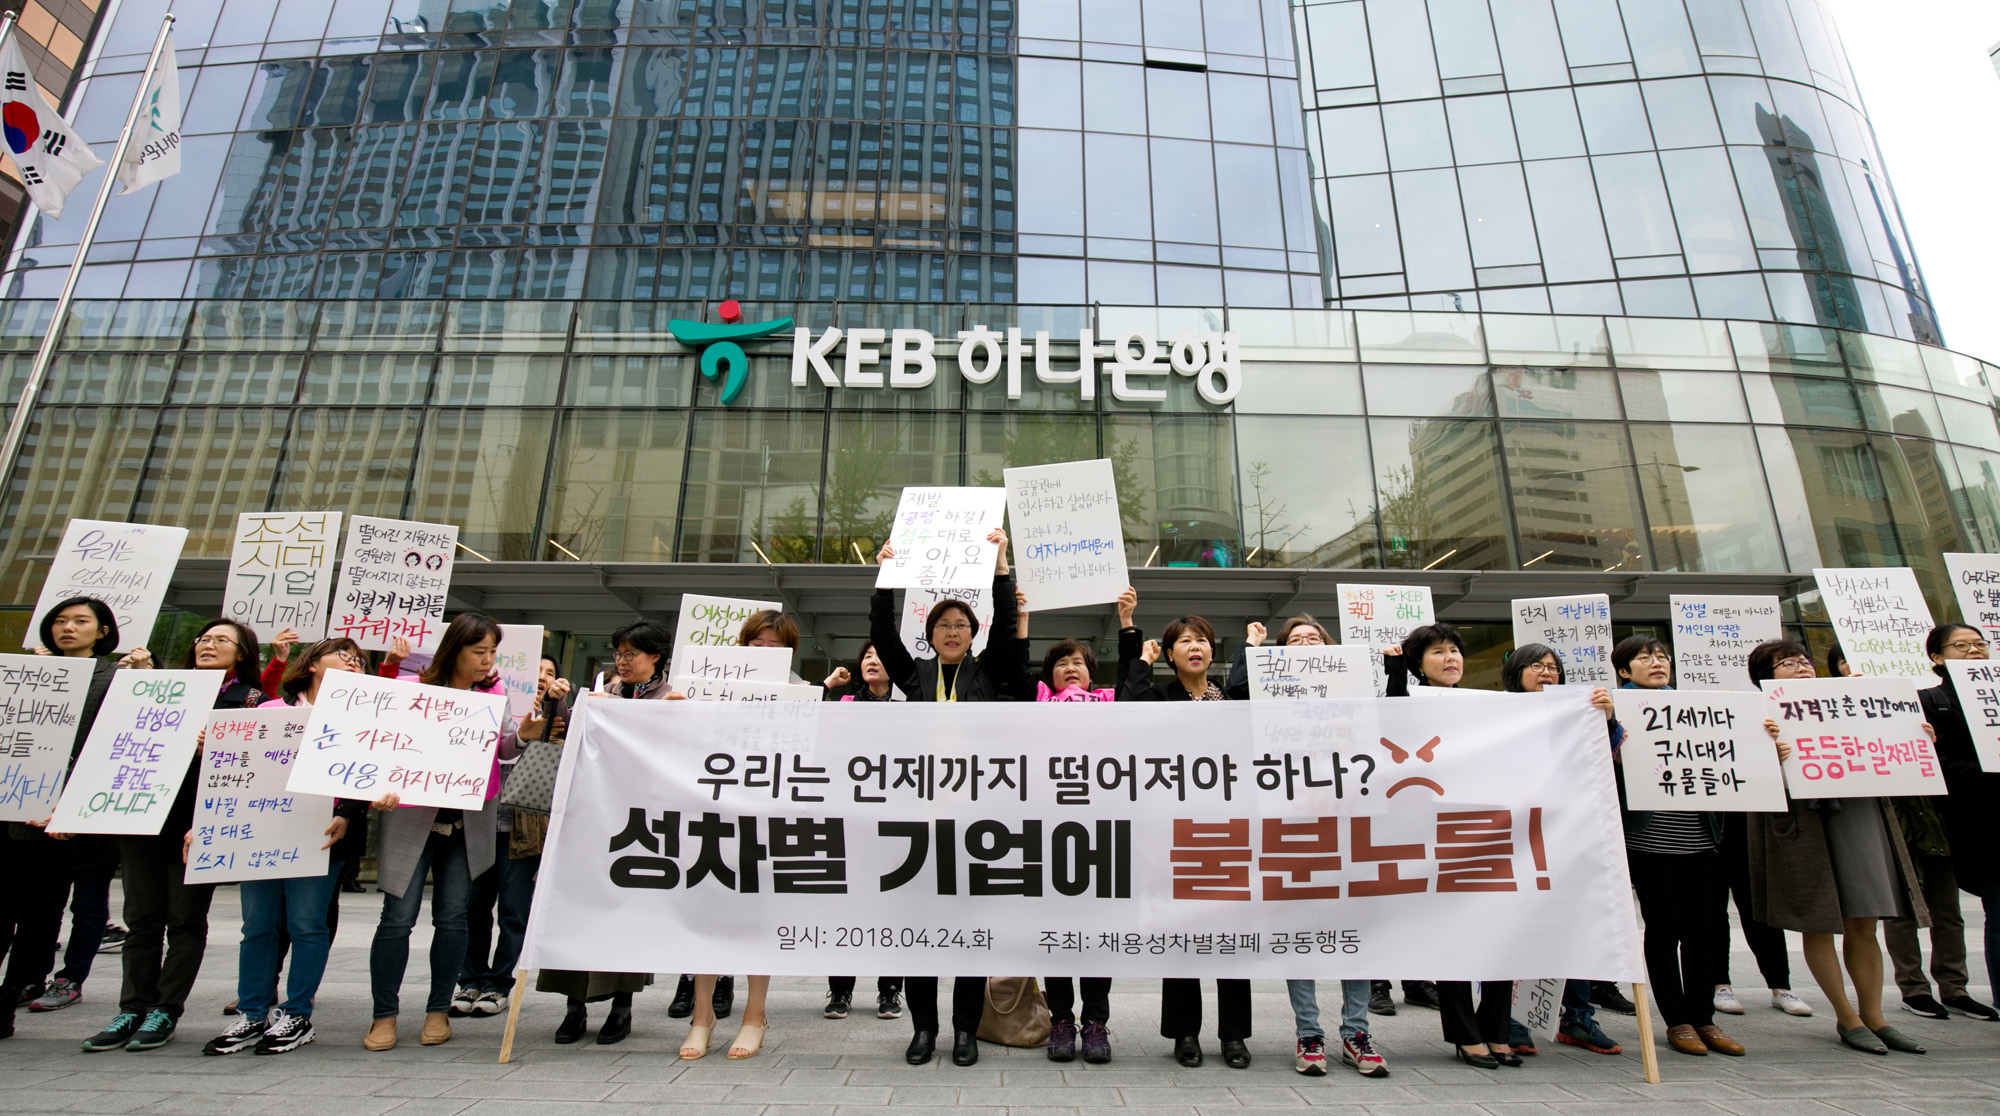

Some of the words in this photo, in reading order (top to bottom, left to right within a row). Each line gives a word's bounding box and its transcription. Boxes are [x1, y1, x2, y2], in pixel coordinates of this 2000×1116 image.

[791, 326, 937, 389] KEB
[957, 324, 1242, 405] 하나은행
[1017, 478, 1061, 497] 금융권에
[1018, 496, 1064, 518] 입사하고
[241, 514, 327, 544] 조선
[359, 524, 400, 545] 떨어진
[403, 529, 450, 549] 지원자는
[1023, 524, 1052, 539] 그러나
[71, 529, 136, 562] 우리는
[238, 543, 324, 570] 시대
[354, 547, 396, 563] 영원히
[71, 566, 153, 590] 언제까지
[236, 570, 316, 596] 기업
[348, 566, 404, 586] 떨어지지
[405, 573, 445, 590] 않는다
[1826, 574, 1889, 597] 남자라서
[346, 589, 397, 616] 이렇게
[398, 593, 444, 618] 너희를
[1400, 590, 1423, 602] KEB
[232, 598, 321, 628] 입니까?!
[1347, 602, 1374, 620] 국민
[1395, 603, 1424, 621] 하나
[1520, 603, 1547, 624] 단지
[1557, 601, 1608, 620] 여남비율
[1744, 606, 1775, 616] 아니라
[1349, 625, 1371, 642] 고객
[1544, 625, 1579, 643] 맞추기
[1585, 623, 1612, 640] 위해
[1677, 624, 1714, 637] 개인의
[1717, 624, 1740, 638] 역량
[1256, 654, 1293, 678] 국민
[1296, 655, 1348, 674] 기만하는
[1571, 645, 1608, 663] 인재를
[1680, 652, 1713, 666] 수많은
[1565, 666, 1609, 683] 당신들은
[1683, 672, 1720, 684] 아직도
[132, 679, 186, 704] 여성은
[1310, 684, 1327, 698] 기업
[330, 688, 398, 717] 이래도
[409, 692, 468, 722] 차별이
[136, 707, 186, 732] 남성의
[1643, 704, 1735, 732] 21세기다
[211, 720, 269, 741] 성차별을
[313, 724, 342, 750] 눈
[355, 729, 423, 754] 가리고
[109, 732, 165, 763] 발판도
[209, 750, 251, 769] 결과를
[1654, 739, 1735, 766] 구시대의
[111, 765, 157, 791] 물건도
[208, 772, 255, 788] 않았나?
[328, 761, 379, 789] 아웅
[697, 752, 831, 803] 우리는
[847, 754, 1029, 804] 언제까지
[1048, 754, 1237, 805] 떨어져야
[1252, 751, 1376, 801] 하나?
[1658, 768, 1746, 797] 유물들아
[88, 792, 157, 815] 아니다
[248, 797, 293, 813] 때까진
[193, 851, 235, 870] 쓰지
[248, 848, 300, 868] 않겠다
[608, 807, 848, 894] 성차별
[878, 818, 1132, 900] 기업에
[1169, 806, 1552, 902] 불분노를!
[777, 925, 827, 950] 일시:
[835, 926, 994, 950] 2018.04.24.화
[1038, 930, 1090, 954] 주최:
[1099, 931, 1261, 955] 채용성차별철폐
[1268, 930, 1361, 954] 공동행동
